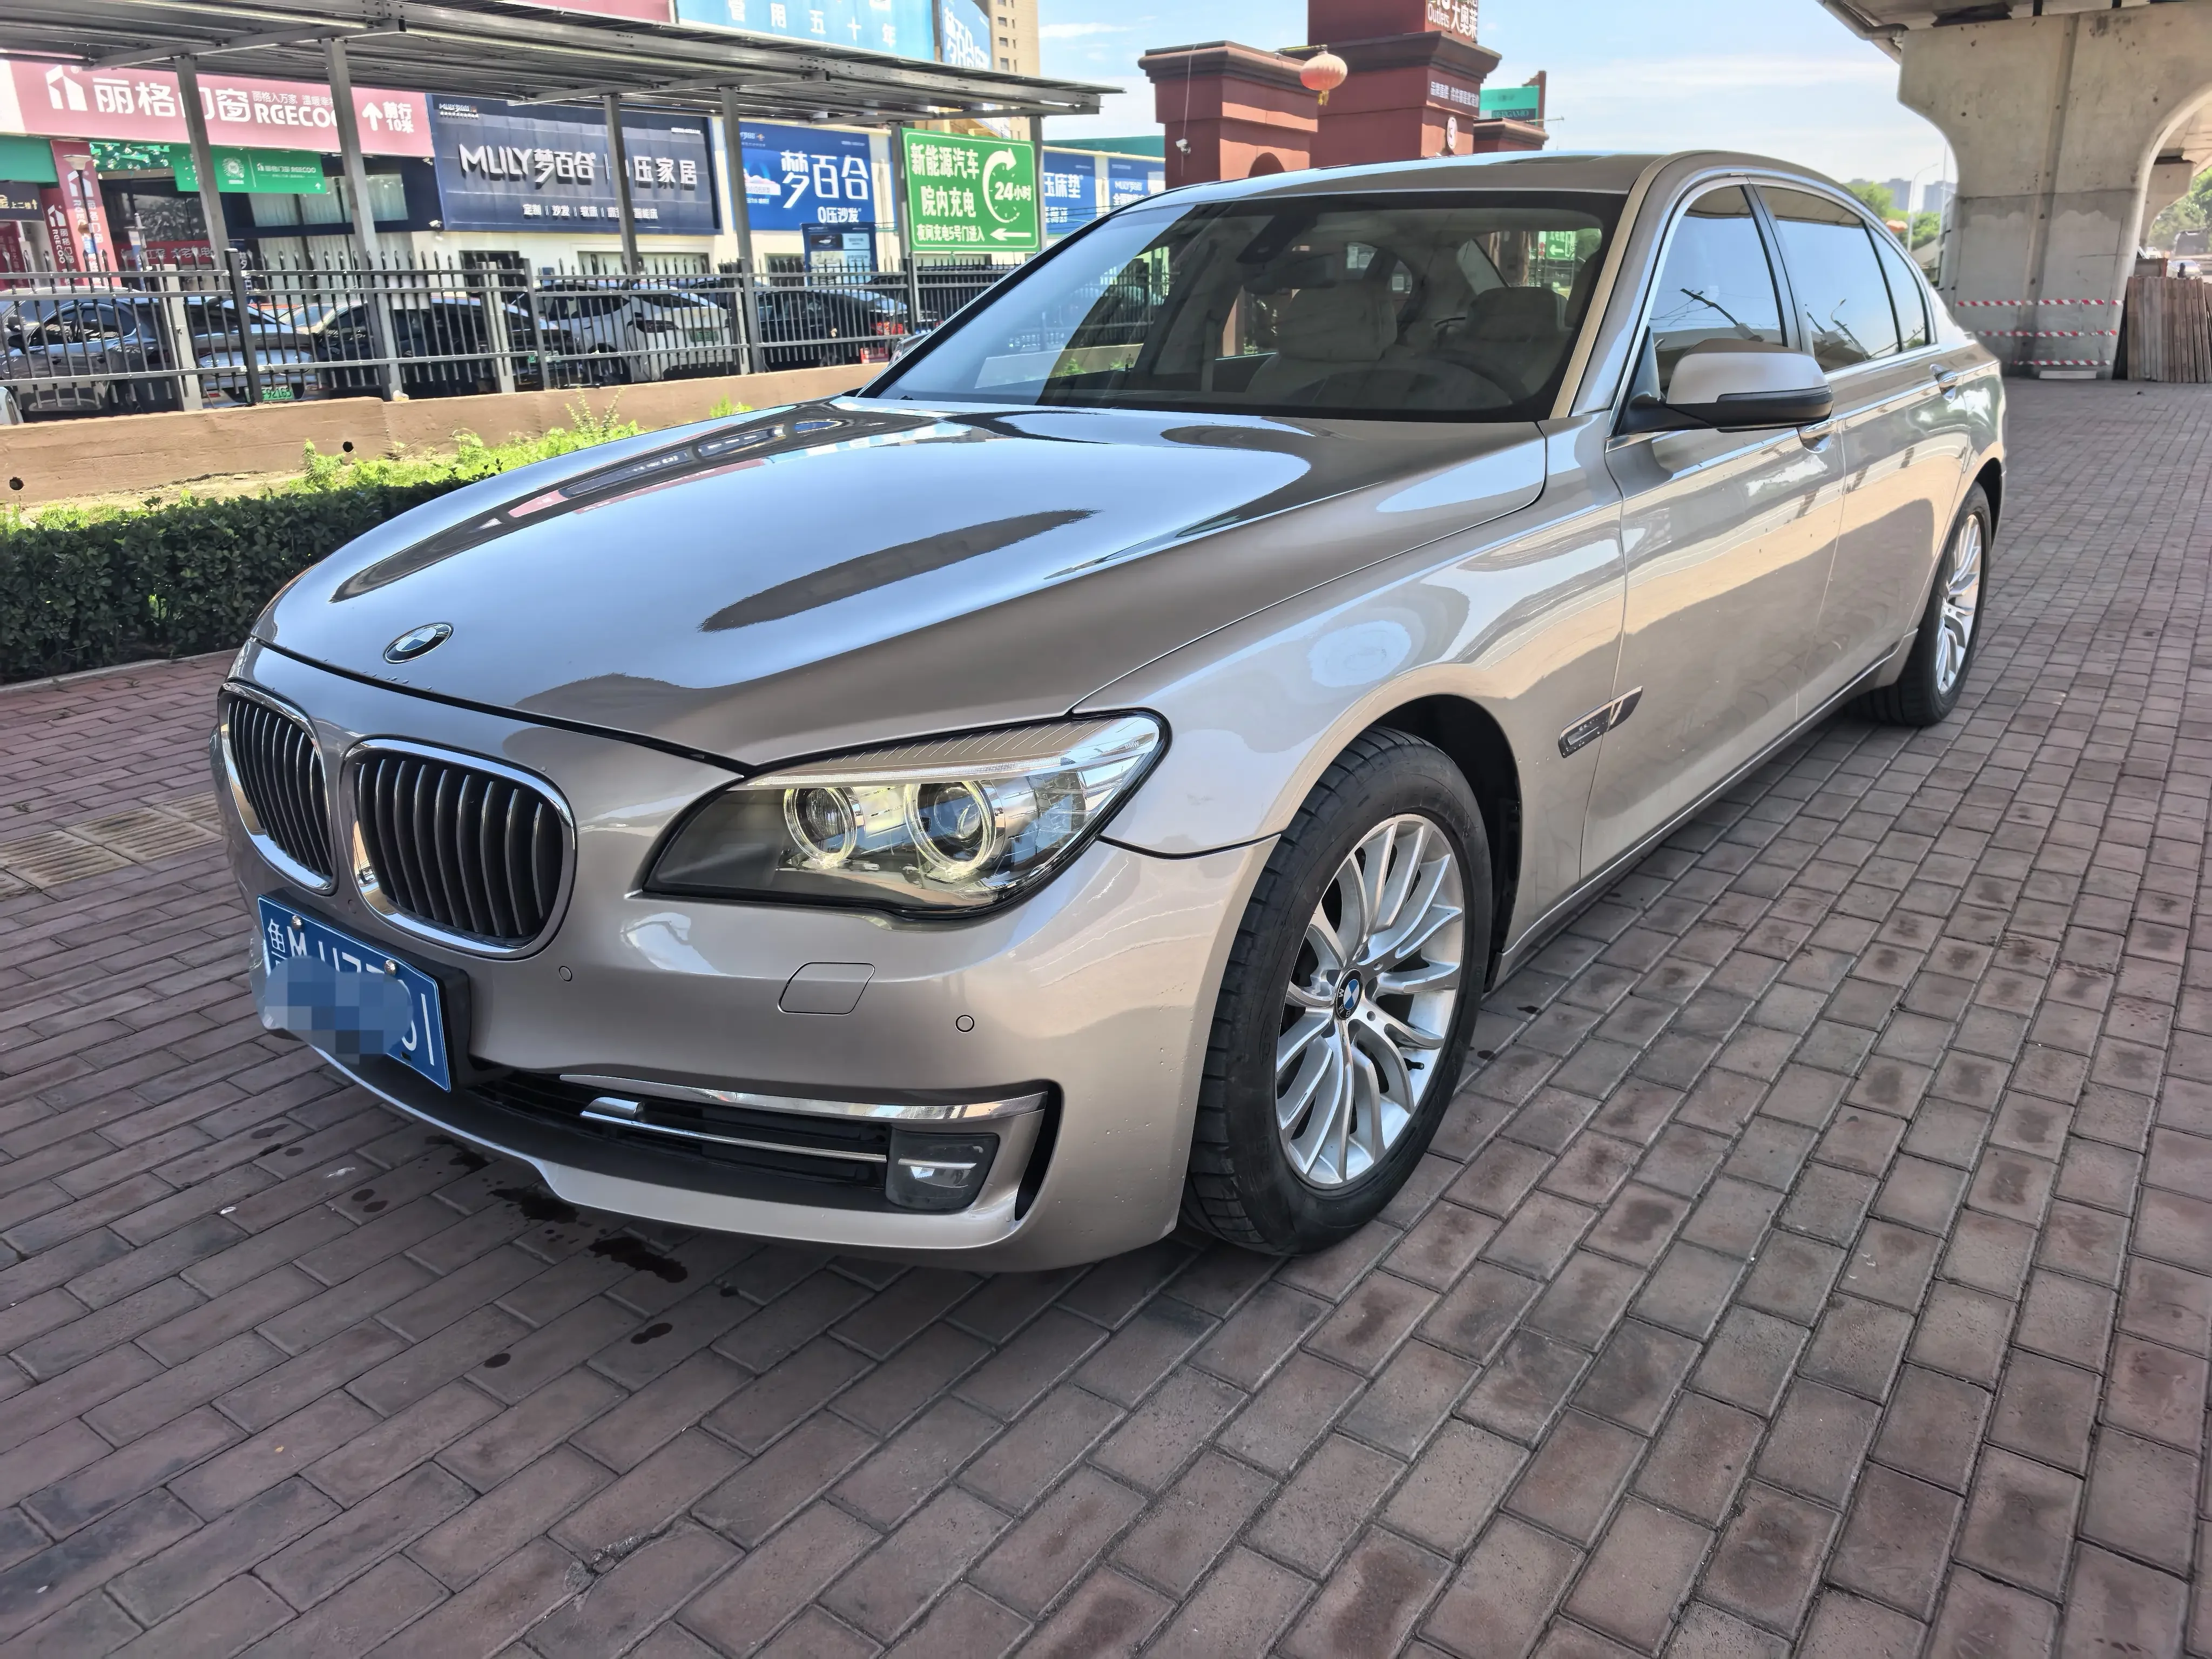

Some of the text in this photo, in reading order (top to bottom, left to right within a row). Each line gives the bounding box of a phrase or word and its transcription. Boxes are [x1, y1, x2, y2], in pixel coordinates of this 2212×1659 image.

[1427, 3, 1450, 28] Outlets
[92, 77, 251, 122] 丽格门窗
[387, 118, 414, 134] 10米
[910, 143, 980, 180] 新能源汽车
[780, 150, 868, 209] 梦百合
[994, 181, 1032, 201] 24小时
[920, 185, 977, 218] 院内充电
[817, 206, 859, 224] 0压沙发
[916, 223, 986, 242] 夜间充电5号门进入
[1125, 740, 1140, 750] BMW
[1338, 988, 1351, 1018] BMW
